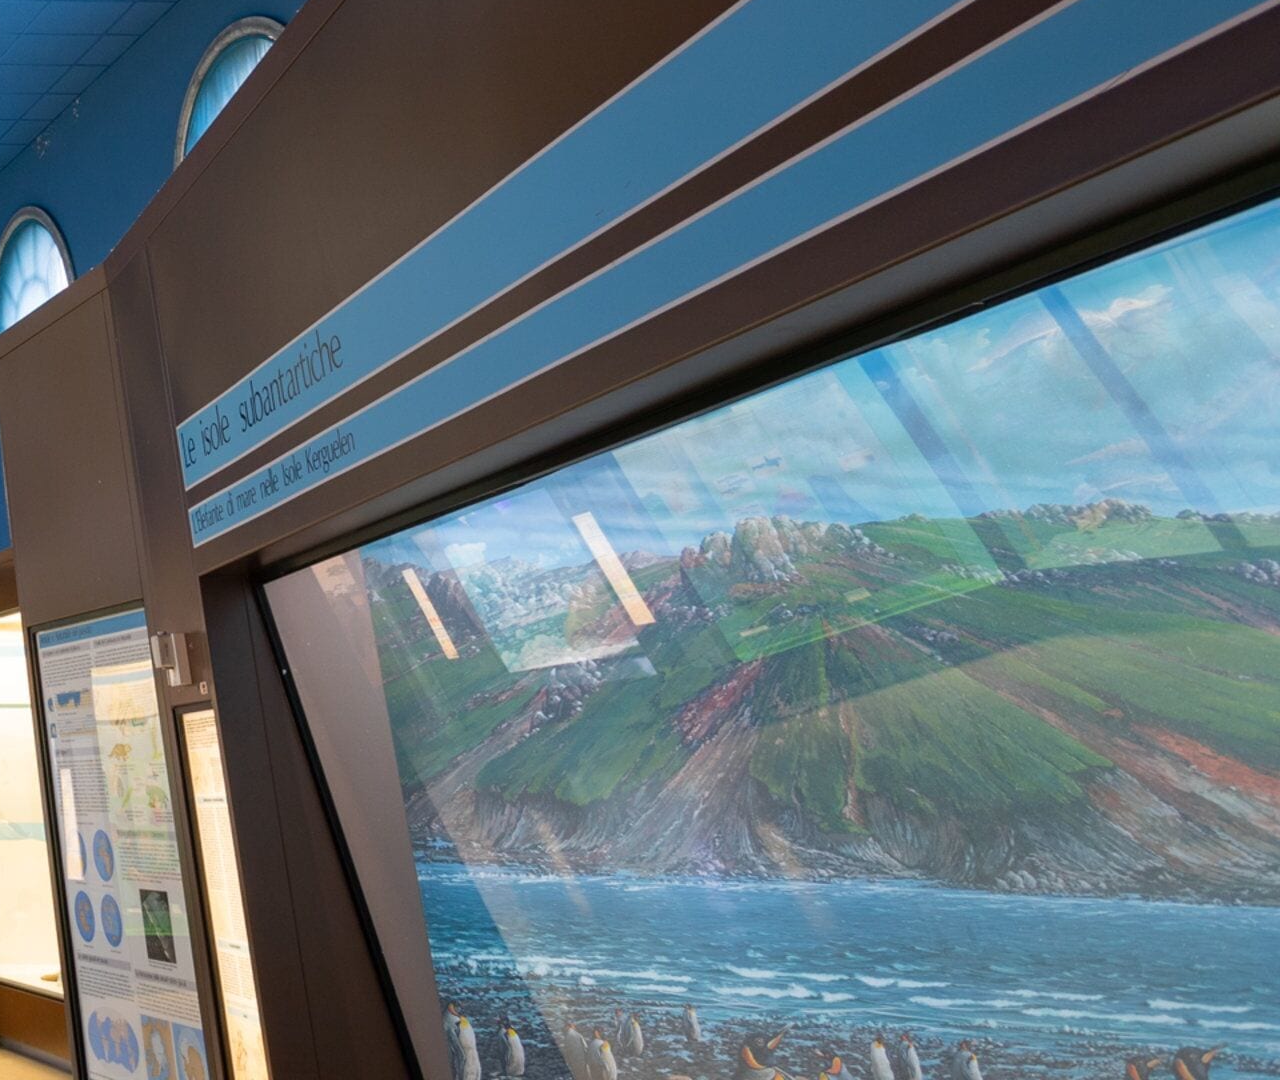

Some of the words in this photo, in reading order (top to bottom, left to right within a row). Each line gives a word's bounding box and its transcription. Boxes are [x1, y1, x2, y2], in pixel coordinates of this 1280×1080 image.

[180, 432, 197, 469] Le
[200, 405, 232, 457] isole
[239, 330, 344, 433] subantartiche
[281, 454, 304, 487] Isole
[305, 428, 357, 474] Kerguelen
